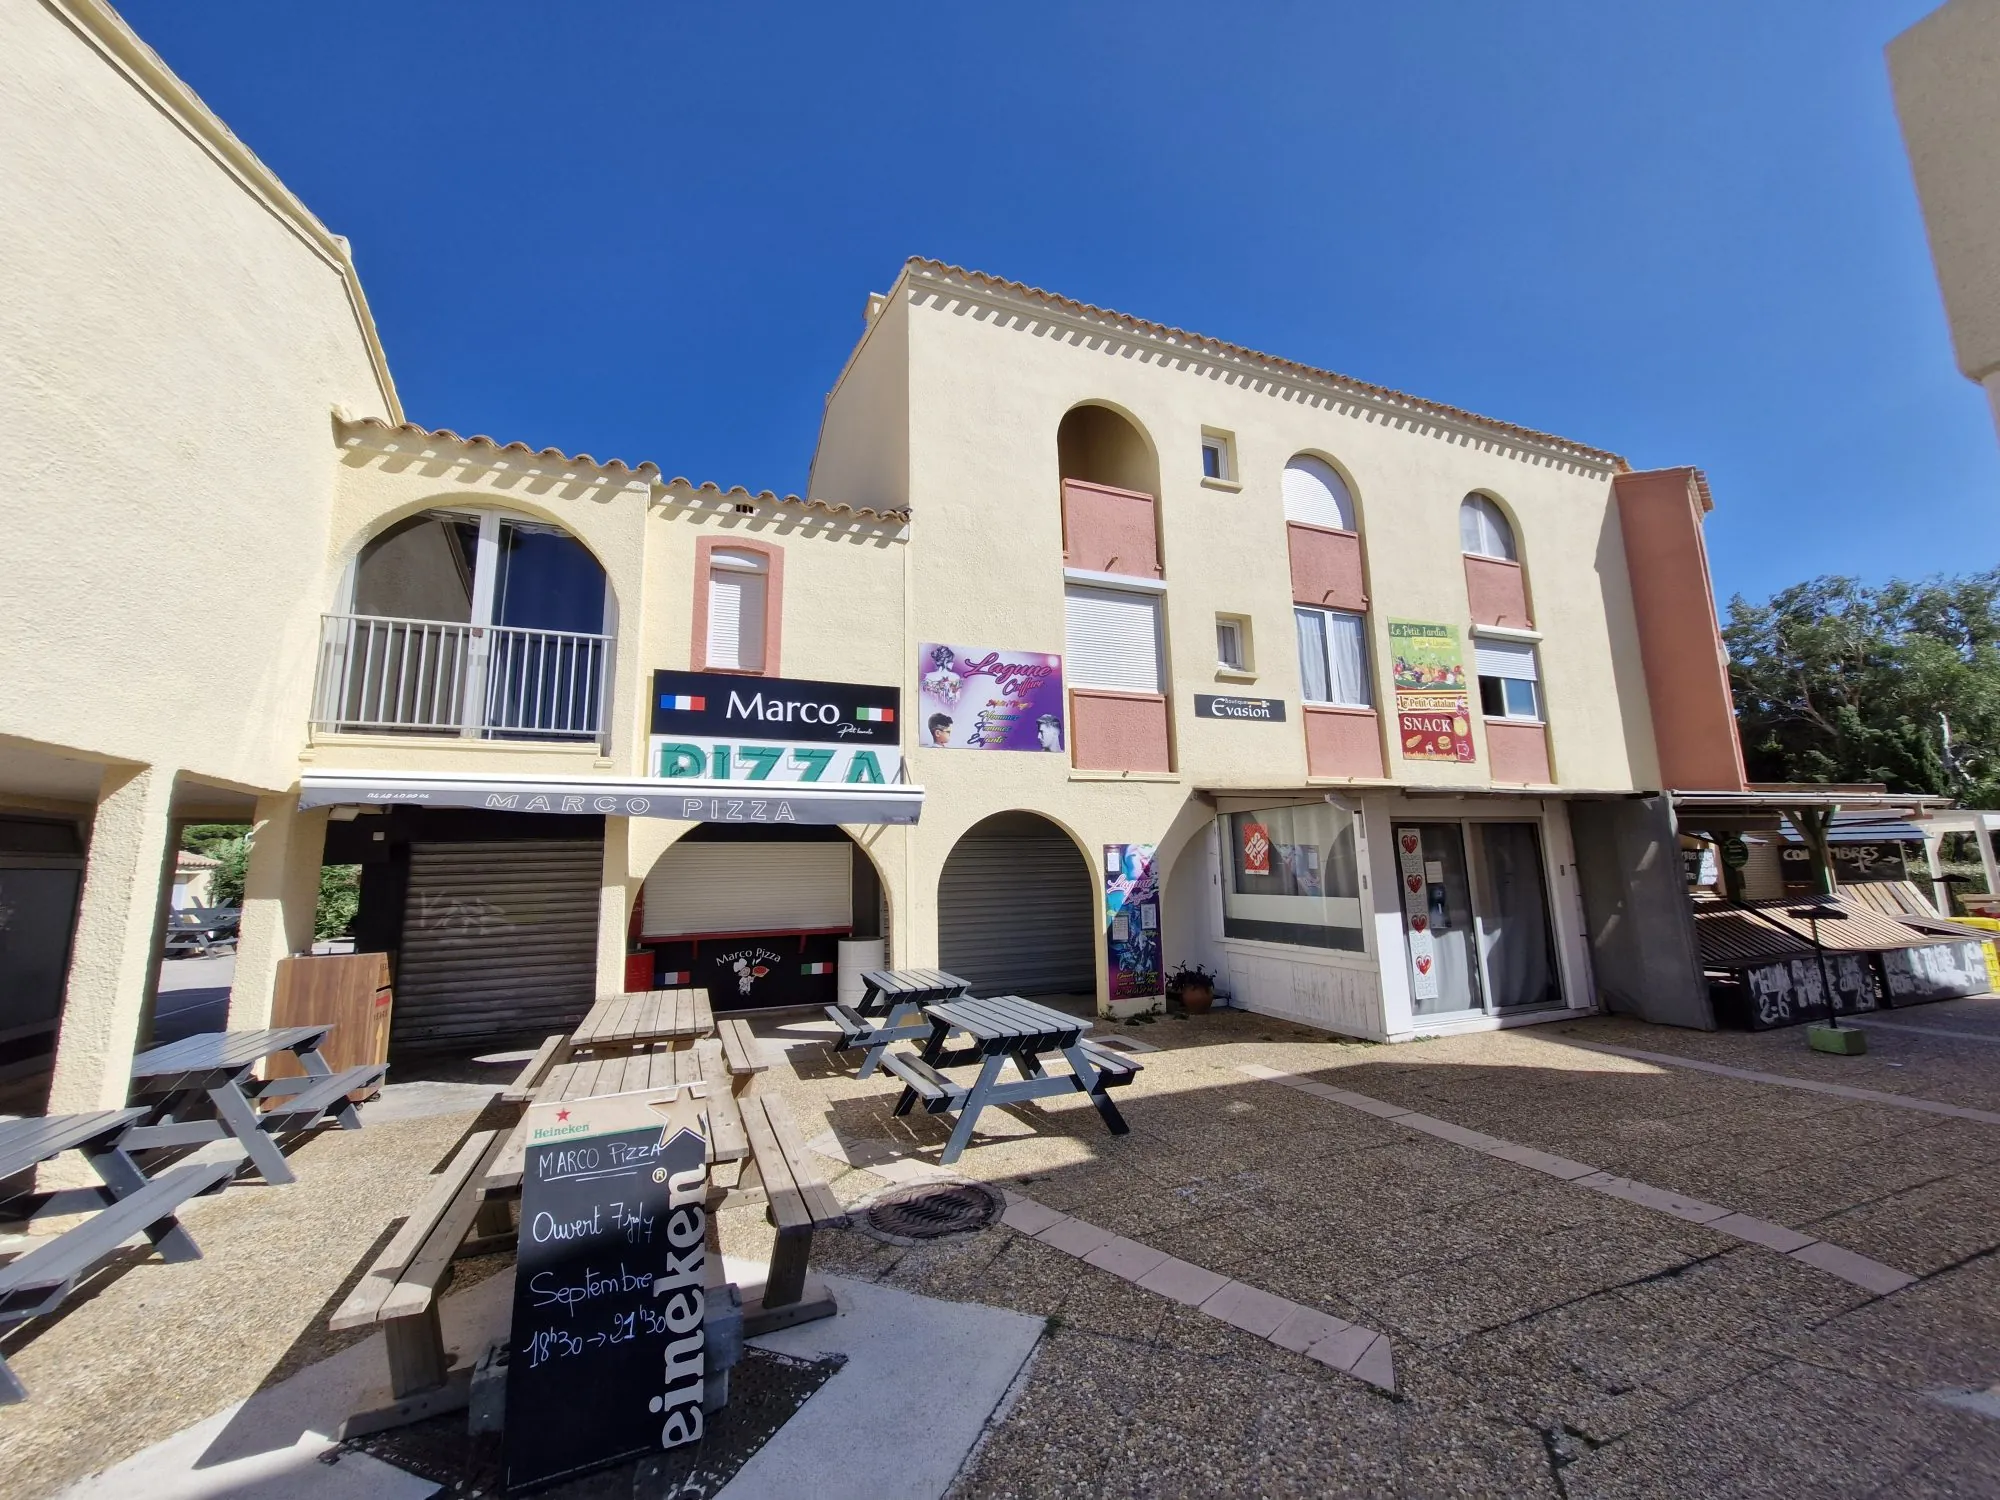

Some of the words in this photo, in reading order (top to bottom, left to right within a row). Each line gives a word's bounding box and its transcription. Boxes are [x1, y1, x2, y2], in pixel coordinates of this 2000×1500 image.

[1391, 625, 1401, 635] Le
[1403, 625, 1421, 636] Petit
[1422, 626, 1447, 637] Jardin
[963, 652, 1052, 684] Lagune
[1002, 677, 1045, 697] Coiffure
[725, 690, 840, 724] Marco
[1211, 698, 1270, 718] Evasion
[1399, 696, 1408, 708] Le
[1409, 698, 1427, 708] Petit
[1428, 699, 1456, 708] Catalan
[1403, 717, 1452, 733] SNACK
[661, 742, 886, 784] PIZZA
[485, 793, 650, 815] MARCO
[682, 799, 796, 821] PIZZA
[715, 949, 753, 967] Marco
[755, 947, 782, 963] Pizza
[533, 1122, 591, 1140] Heineken
[539, 1147, 600, 1179] MARCO
[532, 1204, 603, 1243] Ouvert
[530, 1262, 653, 1318] Septembre
[522, 1326, 583, 1369] 18h30
[609, 1304, 667, 1344] 21h30
